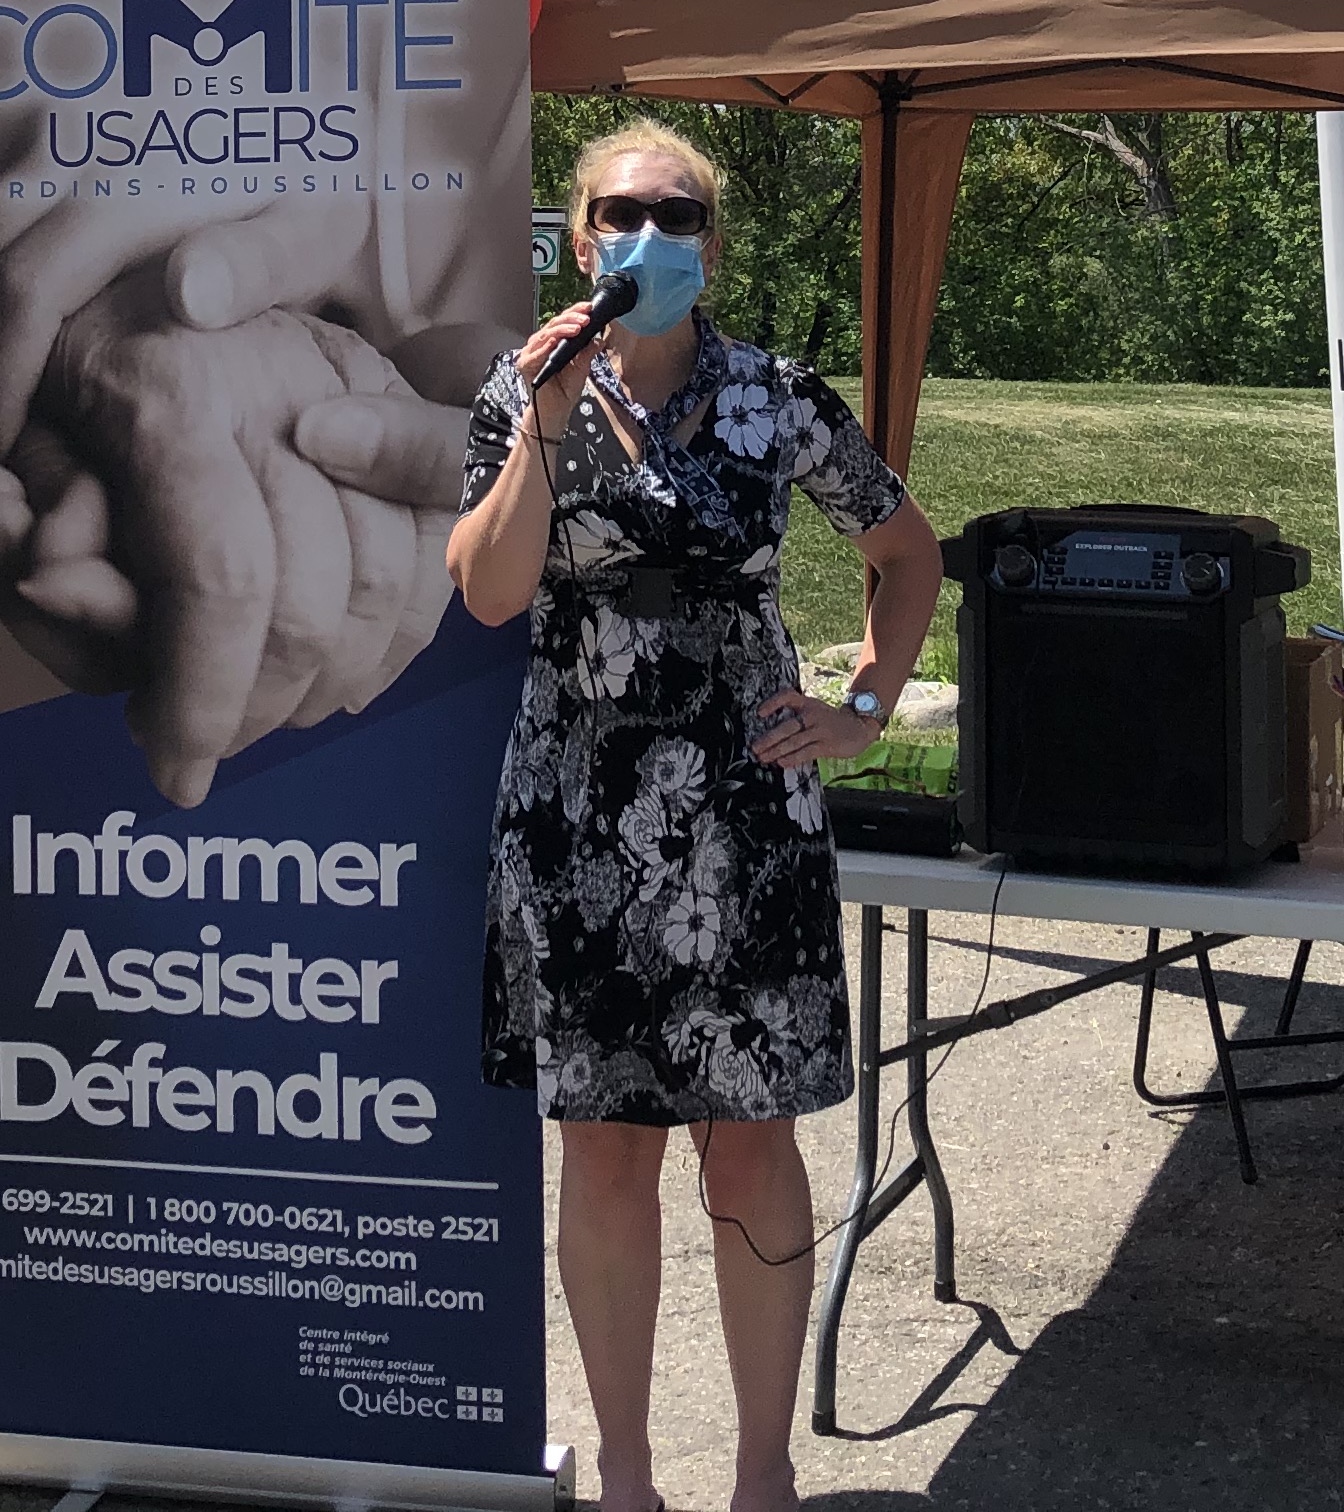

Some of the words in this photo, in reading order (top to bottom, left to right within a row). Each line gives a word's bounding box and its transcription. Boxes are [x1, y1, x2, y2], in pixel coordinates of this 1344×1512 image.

[174, 75, 245, 97] DES
[49, 104, 360, 168] USAGERS
[12, 810, 417, 907] Informer
[34, 924, 399, 1024] Assister
[0, 1038, 438, 1145] Défendre
[2, 1188, 114, 1217] 699-2521
[146, 1196, 157, 1221] 1
[164, 1198, 217, 1225] 800
[222, 1201, 351, 1238] 700-0621,
[357, 1214, 435, 1240] poste
[440, 1216, 499, 1243] 2521
[23, 1226, 417, 1271] www.comitedesusagers.com
[298, 1326, 341, 1340] Centre
[343, 1329, 390, 1345] intégré
[299, 1340, 315, 1351] de
[317, 1341, 353, 1354] santé
[299, 1353, 313, 1364] et
[315, 1353, 331, 1365] de
[334, 1356, 384, 1370] services
[387, 1360, 435, 1373] sociaux
[299, 1366, 315, 1377] de
[318, 1366, 330, 1378] la
[332, 1368, 446, 1387] Montérégie-Ouest
[338, 1383, 451, 1418] Québec
